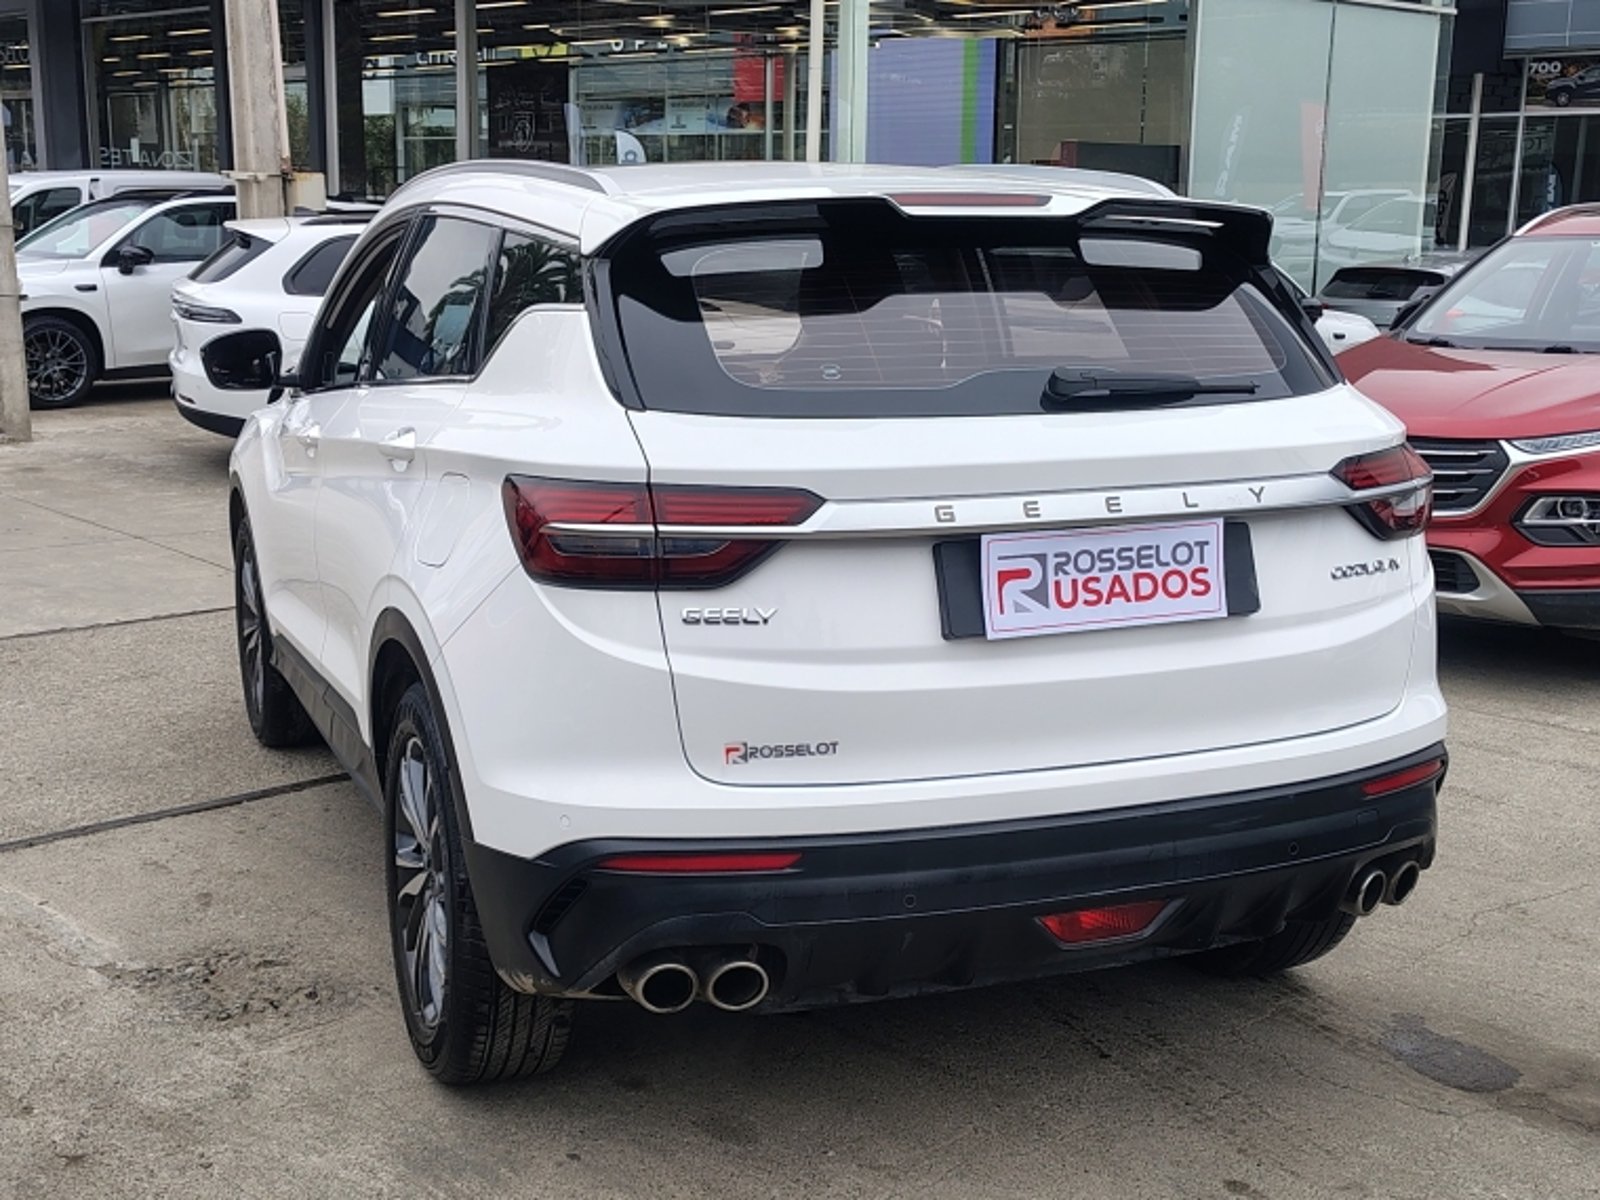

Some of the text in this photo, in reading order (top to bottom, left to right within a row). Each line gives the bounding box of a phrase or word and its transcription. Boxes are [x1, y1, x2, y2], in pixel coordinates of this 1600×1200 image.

[1529, 61, 1562, 75] 700
[934, 486, 1267, 524] GEELY
[1053, 541, 1210, 577] ROSSELOT
[1053, 567, 1211, 609] USADOS
[681, 607, 779, 625] GEELY
[749, 741, 839, 759] ROSSELOT
